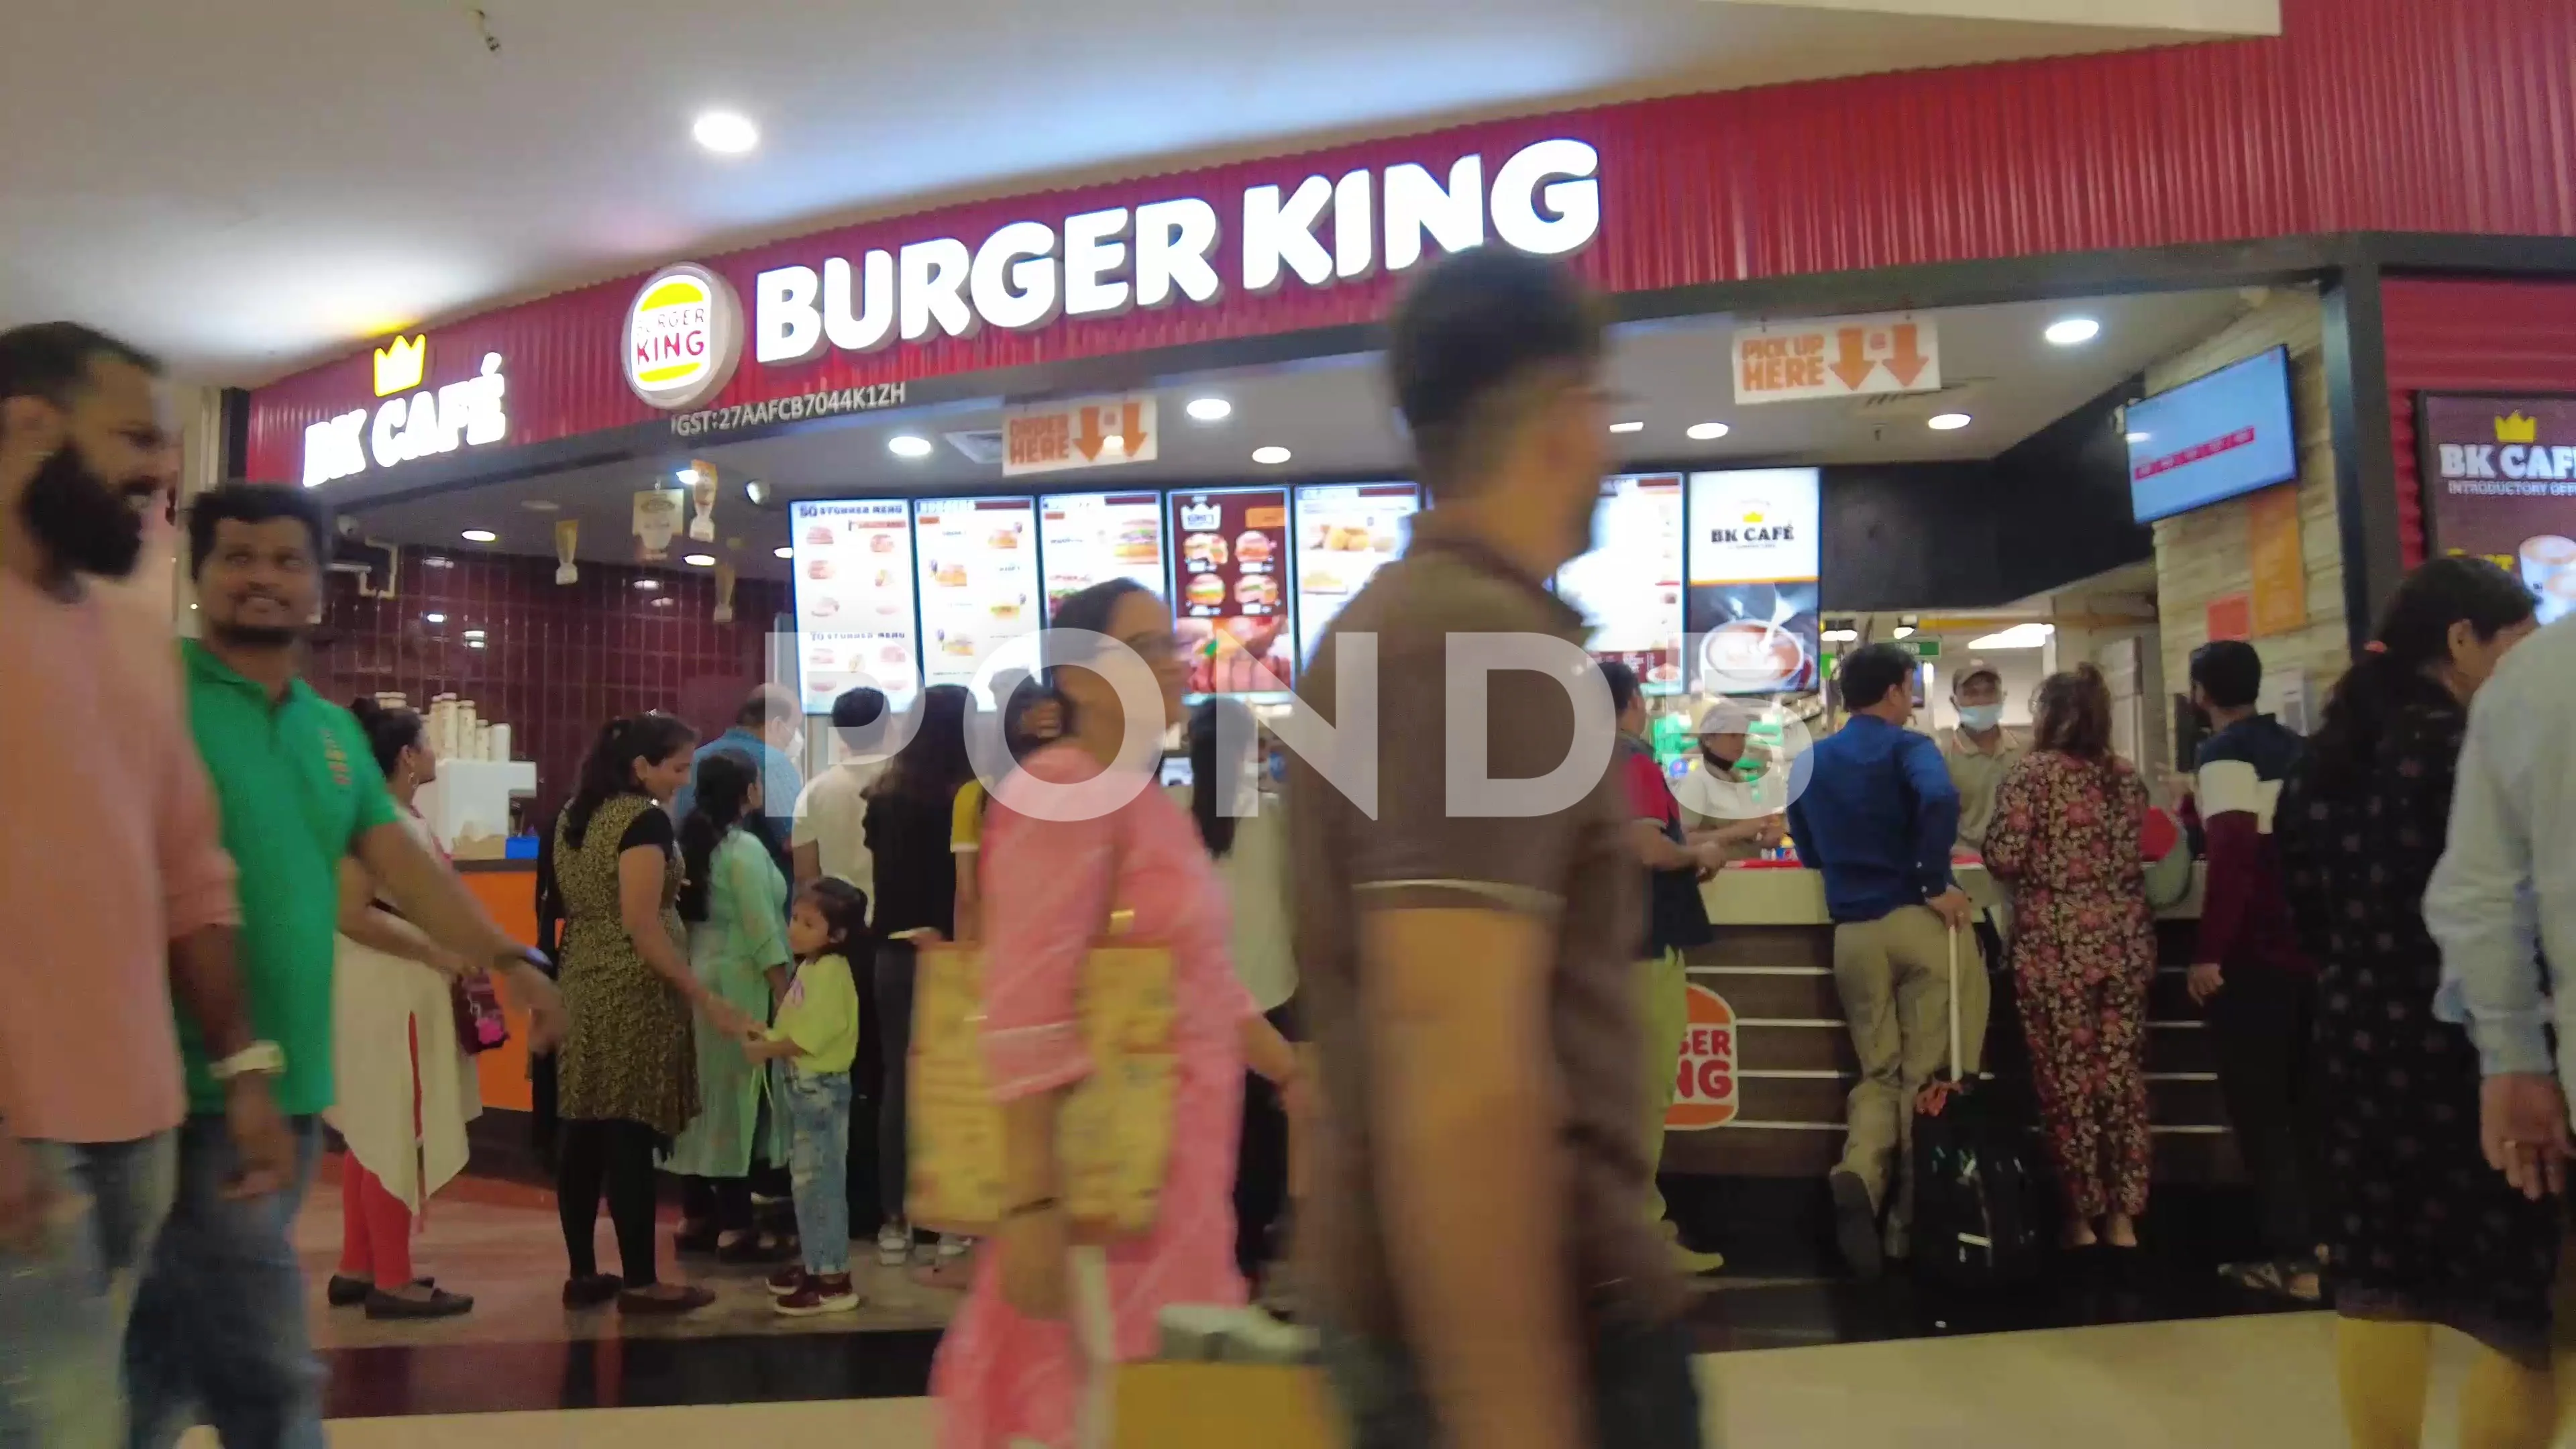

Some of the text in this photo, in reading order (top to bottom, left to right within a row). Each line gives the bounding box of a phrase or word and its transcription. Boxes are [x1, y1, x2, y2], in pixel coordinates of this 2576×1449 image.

[755, 140, 1600, 364] BURGER KING
[637, 330, 704, 365] KING
[1743, 335, 1825, 359] PICK UP
[1743, 356, 1825, 391] HERE
[303, 352, 506, 487] BK CAFÉ
[1010, 413, 1069, 439] ORDER
[1010, 435, 1069, 464] HERE
[2438, 444, 2576, 480] BK CAF
[2449, 480, 2547, 496] INTRODUCTORY
[1711, 519, 1794, 543] BK CAFÉ
